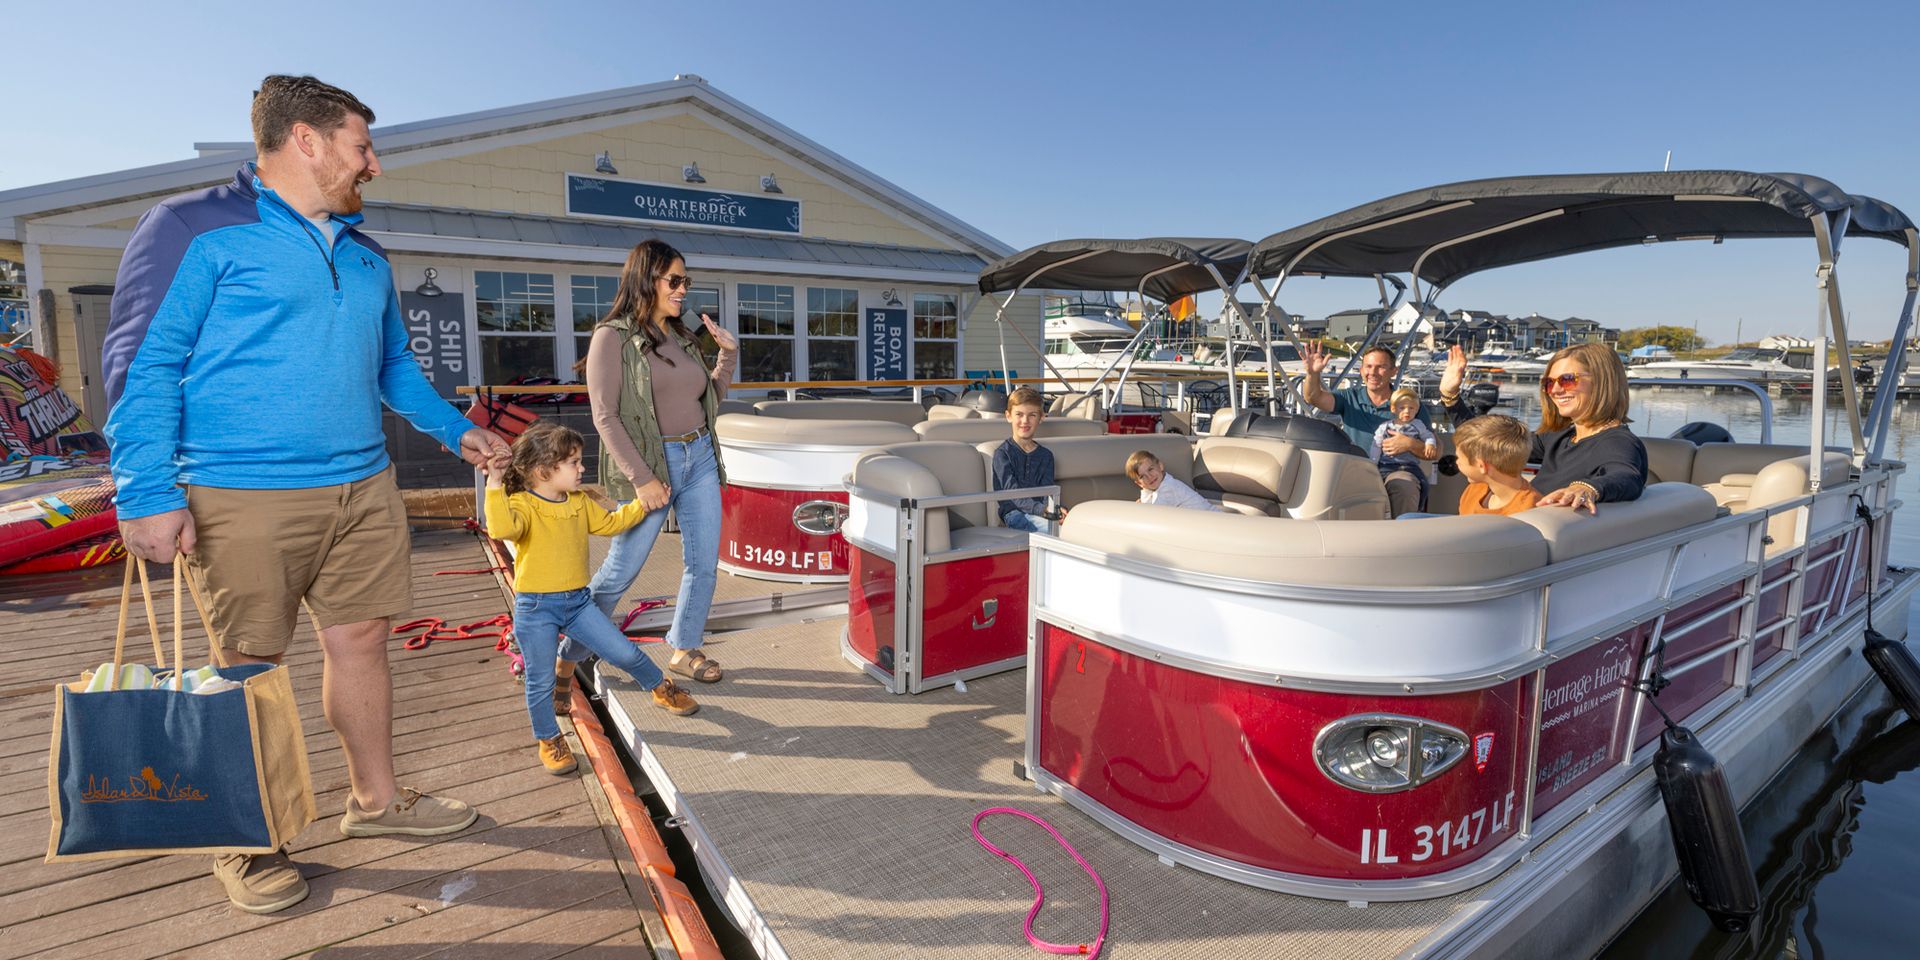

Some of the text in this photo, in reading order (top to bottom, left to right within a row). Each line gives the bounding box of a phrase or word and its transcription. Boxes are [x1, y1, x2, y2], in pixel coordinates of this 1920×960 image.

[634, 195, 747, 217] QUARTERDECK
[648, 207, 737, 224] MARINA OFFICE
[439, 320, 462, 373] SHIP
[890, 326, 902, 371] BOAT
[24, 387, 40, 401] BIG
[729, 540, 741, 559] IL
[744, 544, 786, 566] 3149
[791, 551, 815, 569] LF
[1076, 641, 1086, 673] 2
[1573, 697, 1599, 717] MARINA
[161, 772, 204, 800] Vista
[1360, 790, 1515, 864] IL 3147 LF
